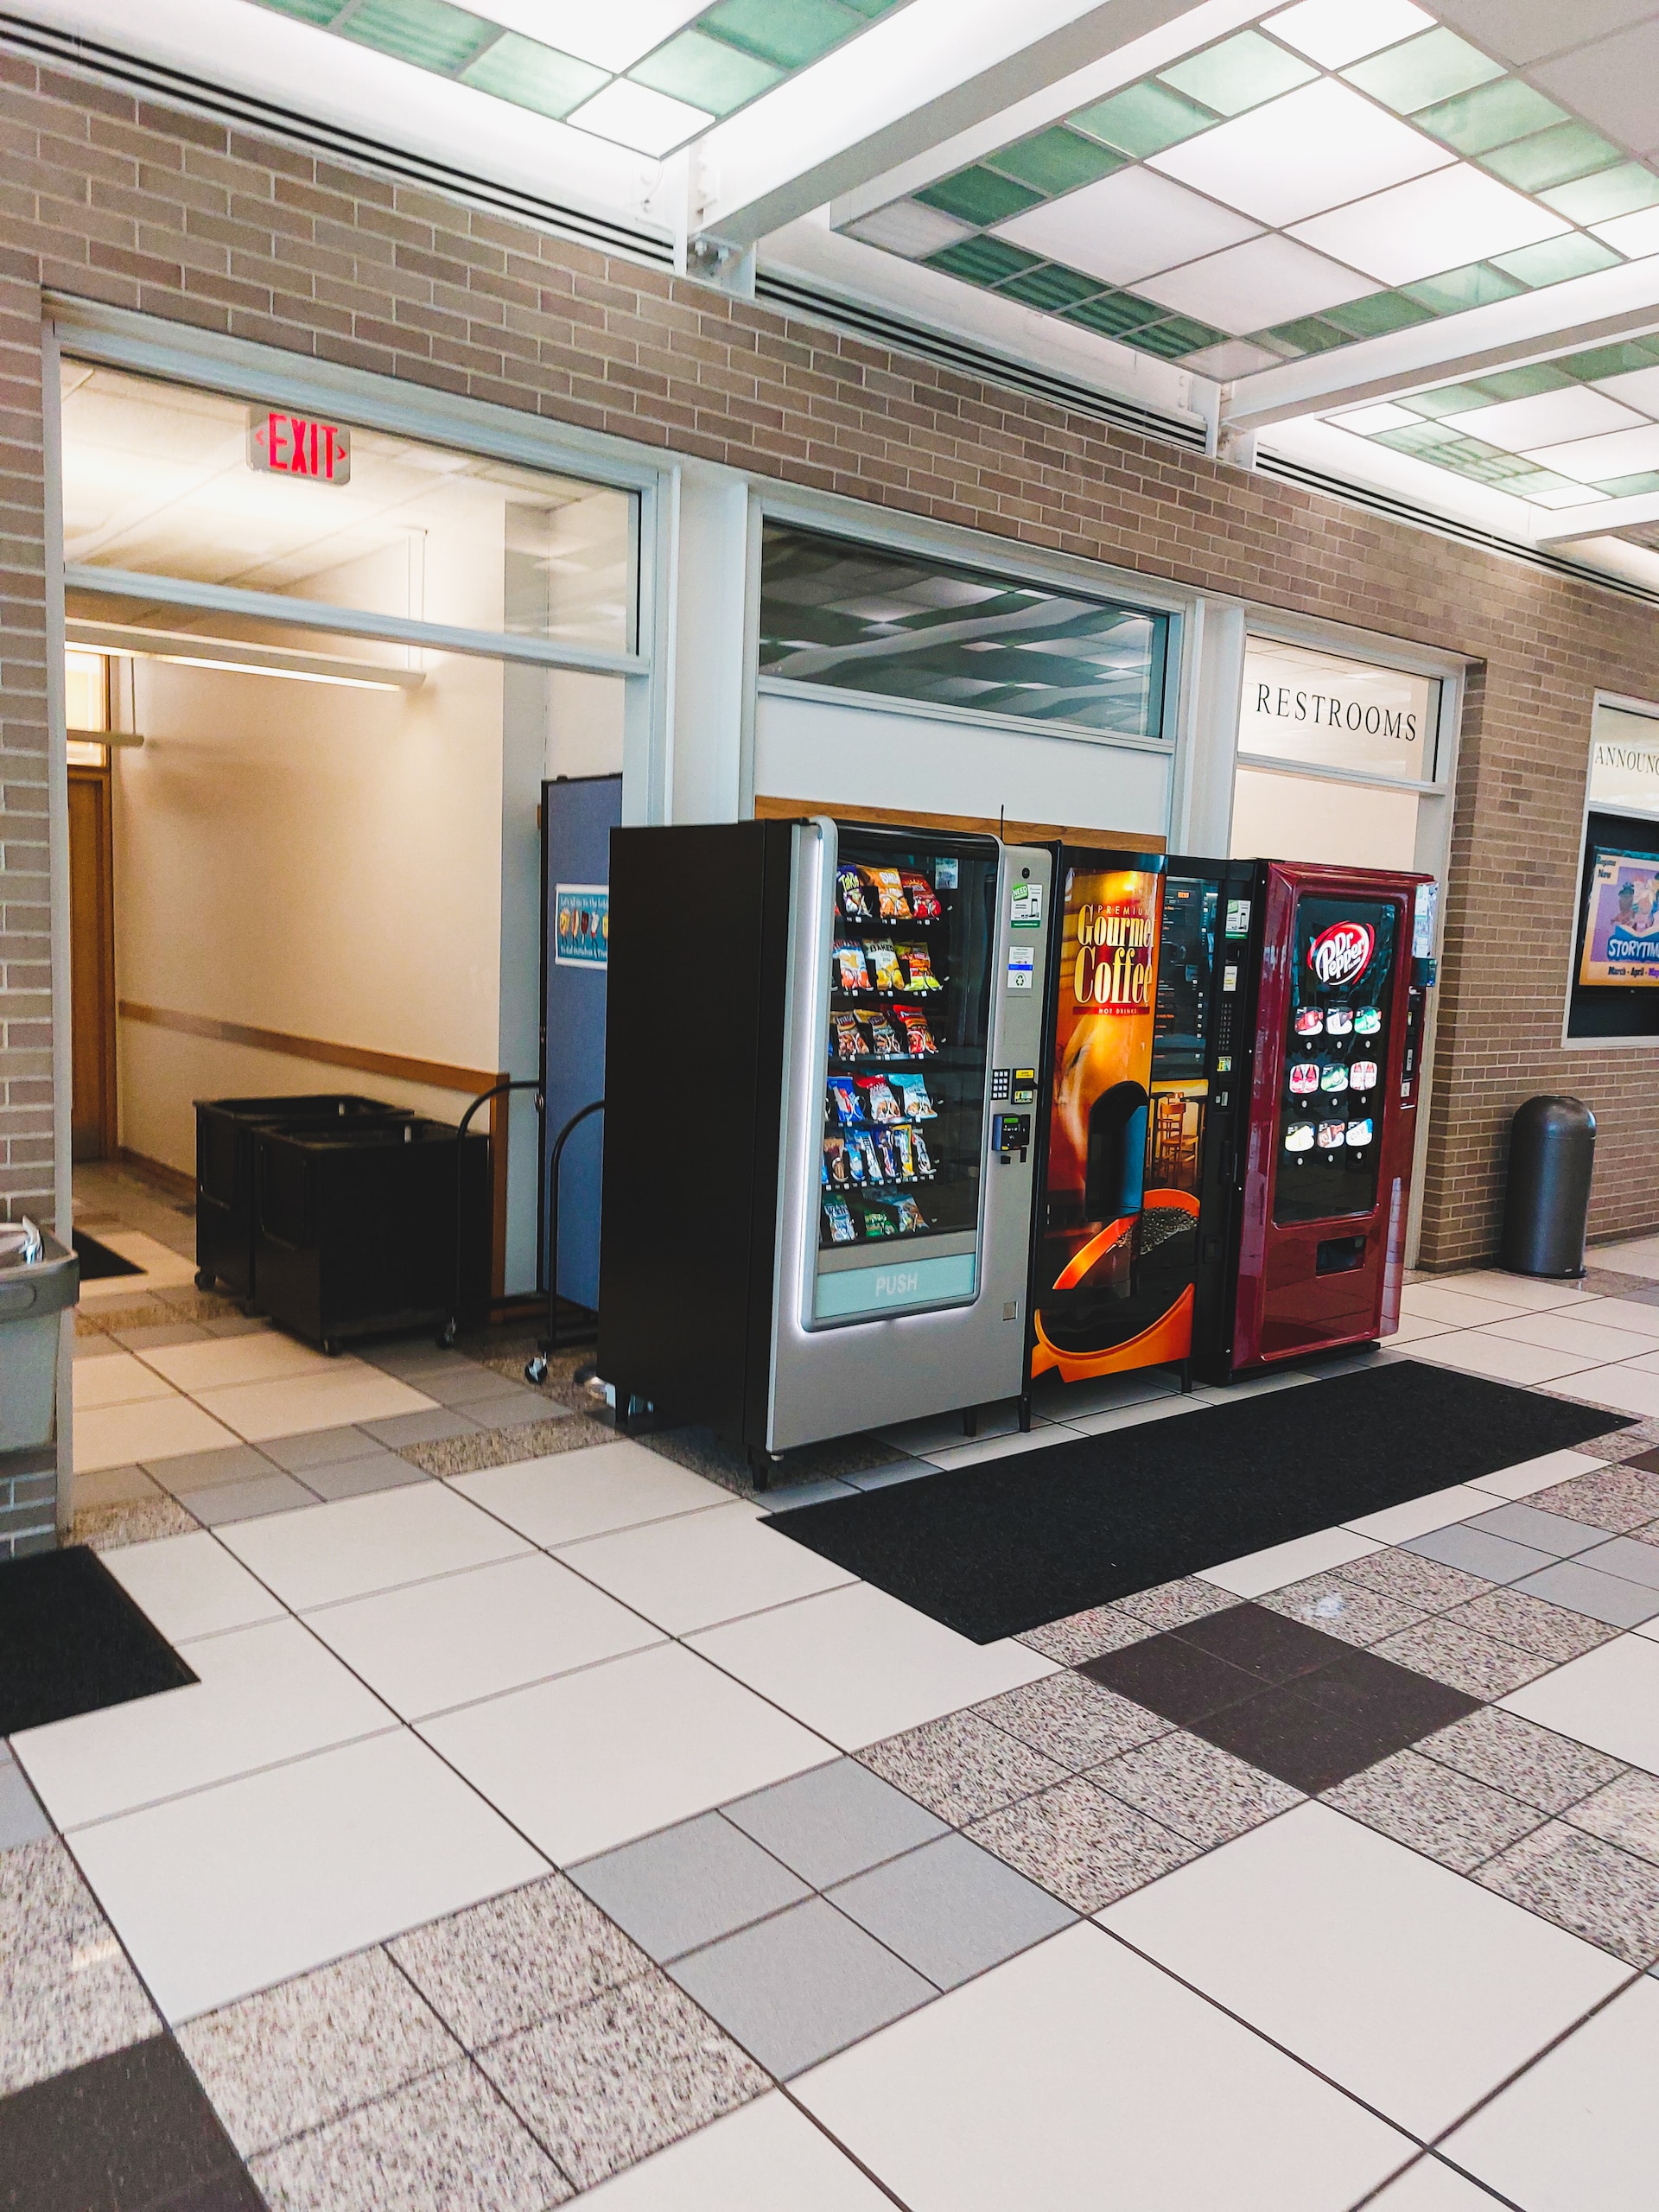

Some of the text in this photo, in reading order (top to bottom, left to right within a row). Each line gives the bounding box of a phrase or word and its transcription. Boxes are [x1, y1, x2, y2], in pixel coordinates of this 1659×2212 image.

[269, 412, 338, 480] EXIT
[1256, 683, 1417, 741] RESTROOMS
[1013, 886, 1027, 897] NEED
[1077, 904, 1156, 948] Gourmet
[1334, 931, 1354, 956] Dr
[1074, 946, 1153, 1006] Coffee
[1322, 938, 1365, 983] Pepper
[1630, 967, 1644, 978] April
[875, 1274, 918, 1296] PUSH
